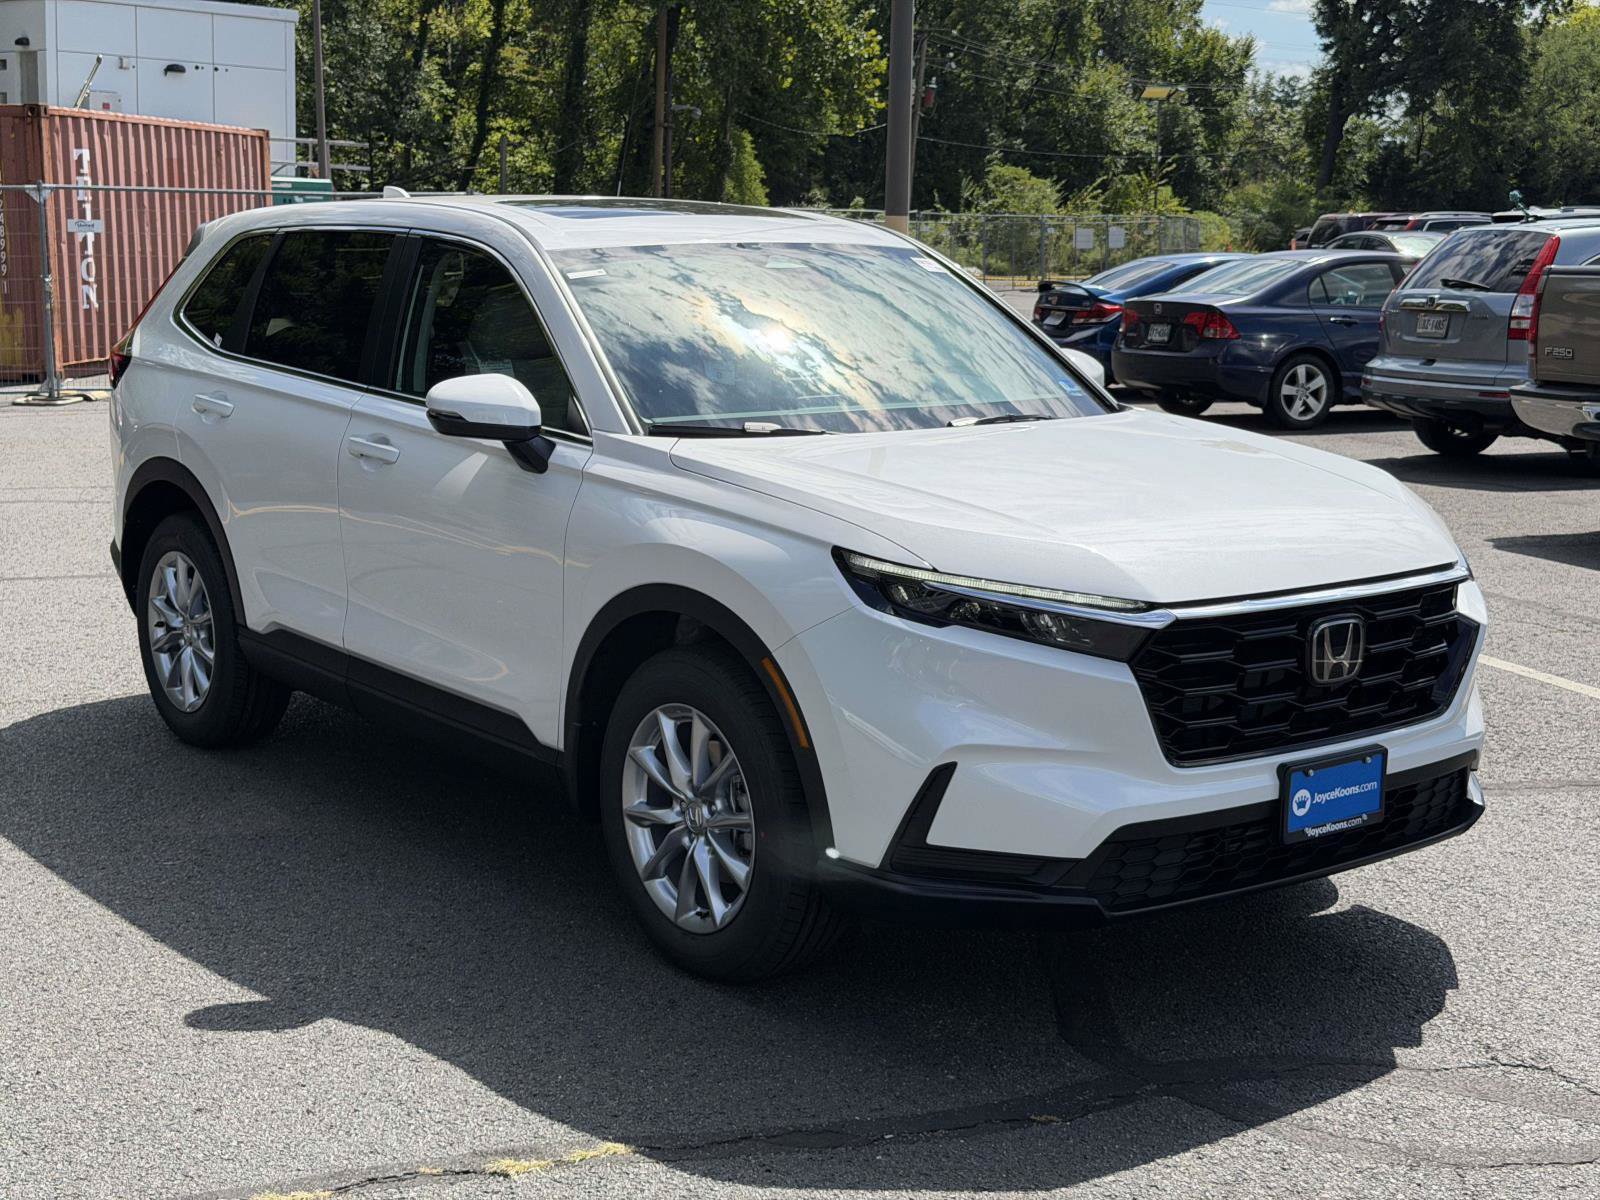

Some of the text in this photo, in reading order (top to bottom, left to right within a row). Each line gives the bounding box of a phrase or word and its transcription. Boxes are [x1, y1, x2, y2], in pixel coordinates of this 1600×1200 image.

[1544, 347, 1573, 357] F250
[1312, 781, 1377, 804] JoyceKoons.com
[1307, 817, 1362, 837] JoyceKoons.com
